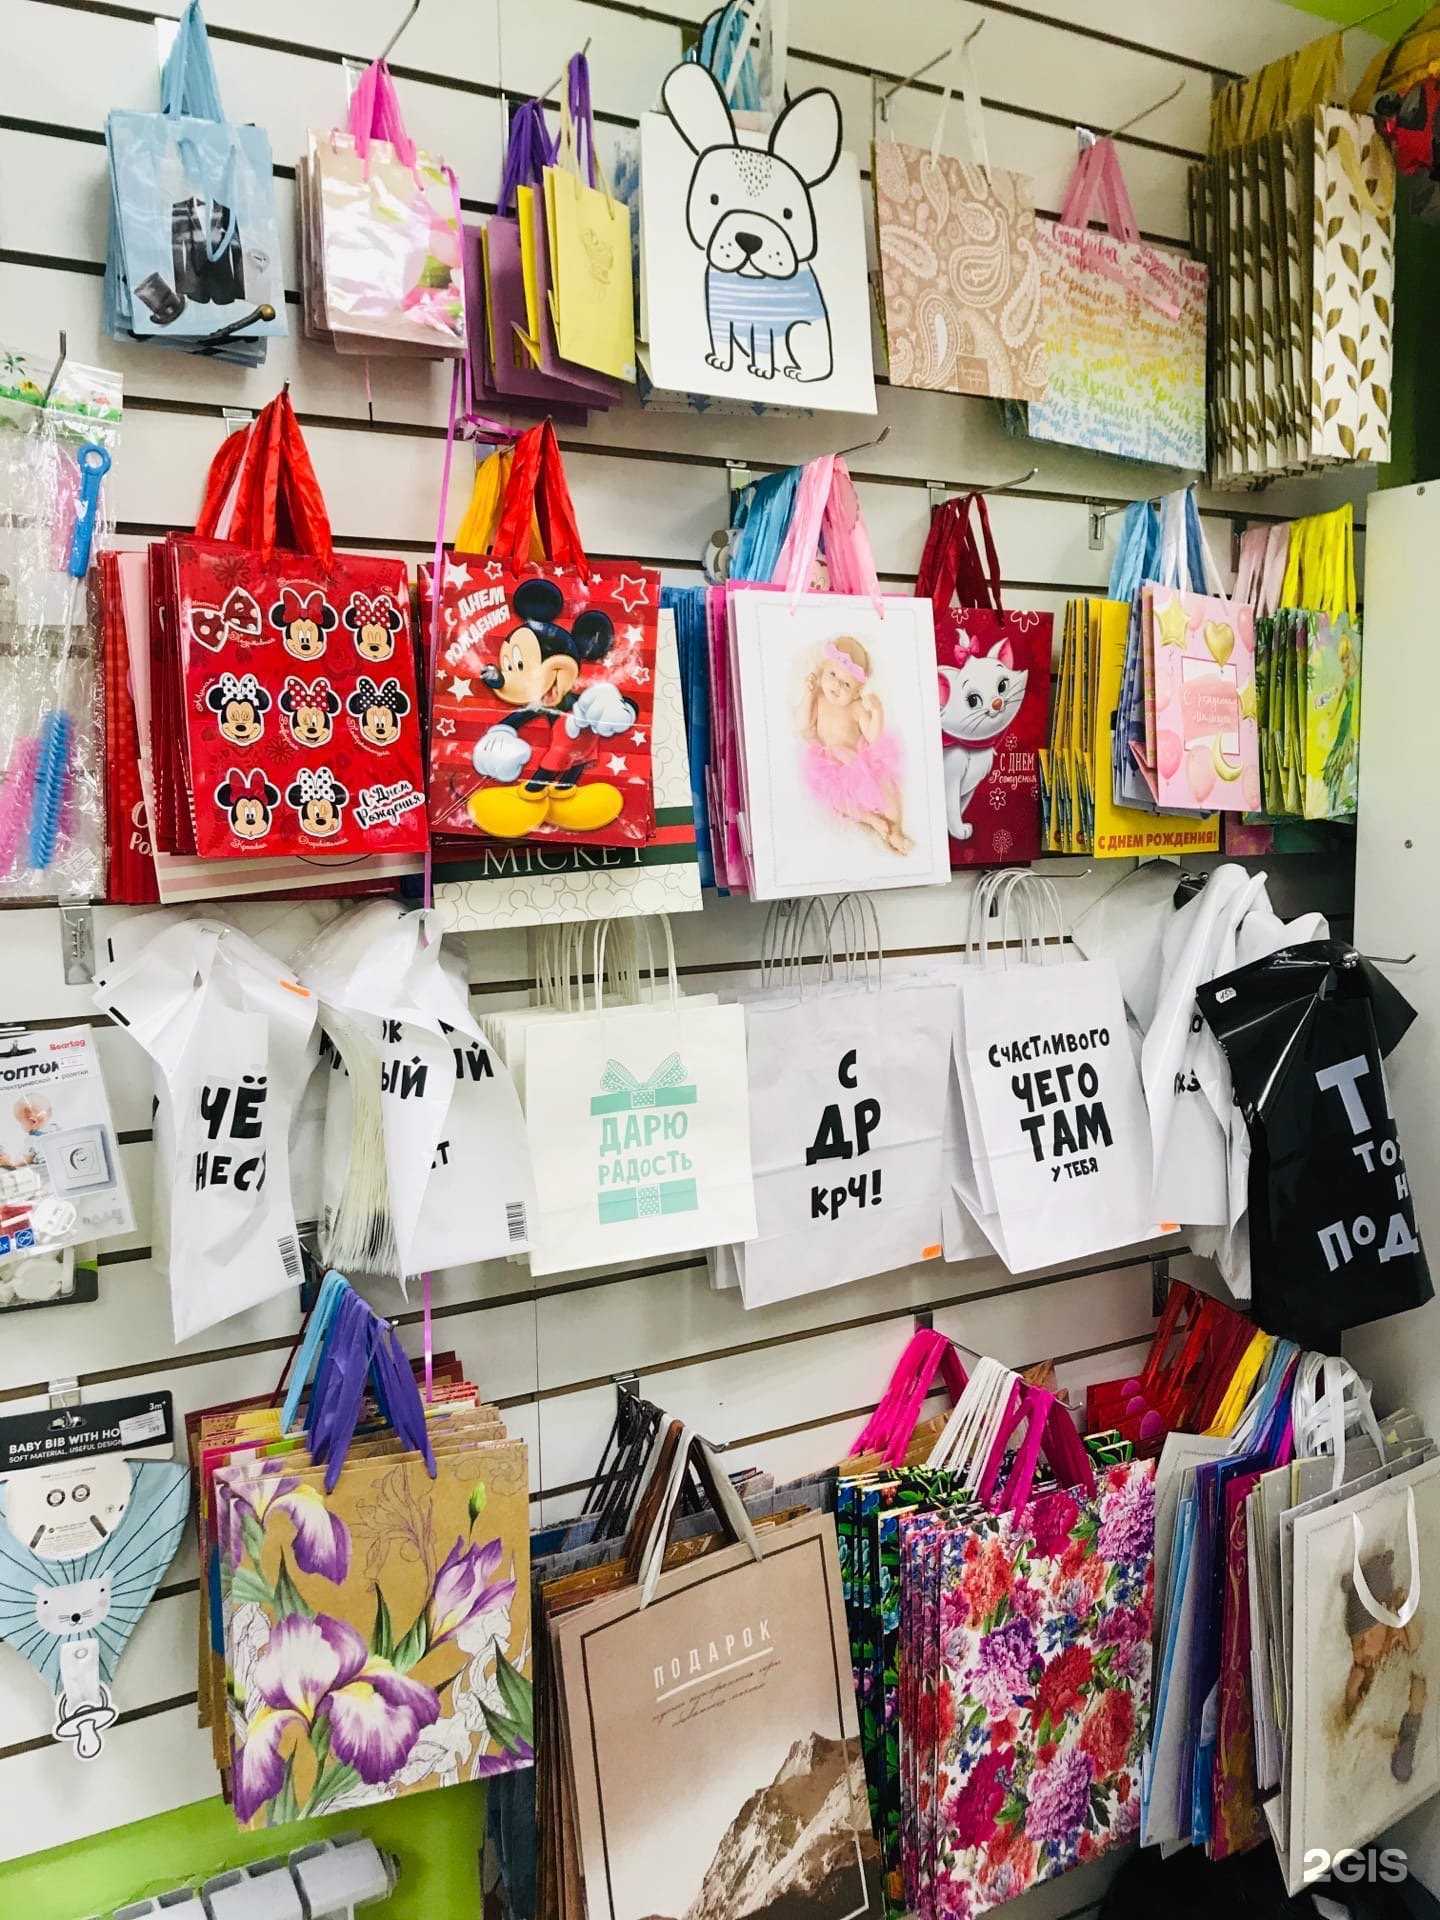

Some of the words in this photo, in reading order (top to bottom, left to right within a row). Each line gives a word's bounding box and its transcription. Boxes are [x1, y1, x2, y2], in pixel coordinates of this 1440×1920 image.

[458, 585, 506, 620] ДНЕМ
[445, 604, 511, 667] РОЖДЕНИЯ
[1001, 753, 1006, 771] С
[1008, 753, 1035, 774] ДНЕМ
[1098, 835, 1106, 850] С
[1107, 832, 1143, 851] ДНЕМ
[1145, 830, 1217, 848] РОЖДЕНИЯ!
[838, 1049, 858, 1089] С
[1012, 1062, 1099, 1112] ЧЕГО
[200, 1075, 267, 1140] ЧЁ
[600, 1111, 688, 1157] ДАРЮ
[806, 1098, 881, 1166] ДР
[1020, 1102, 1114, 1162] ТАМ
[598, 1150, 693, 1186] РАДОСТЬ
[1063, 1157, 1099, 1179] ТЕБЯ
[8, 1453, 28, 1464] SOFT
[69, 1444, 96, 1454] USEFUL
[9, 1440, 42, 1455] BABY
[45, 1437, 65, 1450] BIB
[69, 1431, 99, 1445] WITH
[653, 1619, 771, 1689] ПОДАРОК
